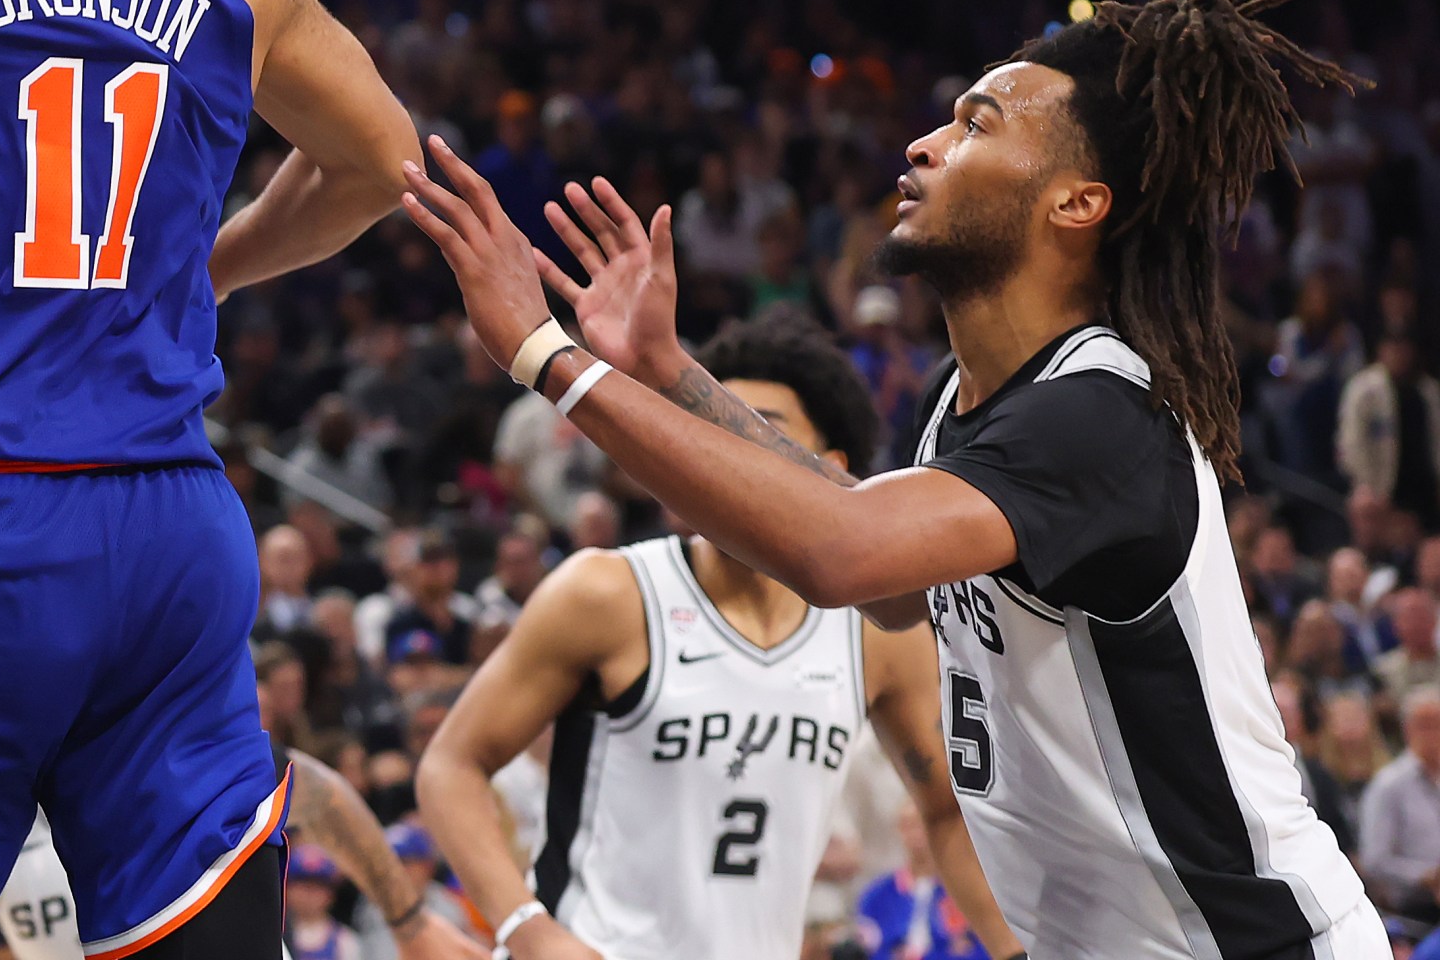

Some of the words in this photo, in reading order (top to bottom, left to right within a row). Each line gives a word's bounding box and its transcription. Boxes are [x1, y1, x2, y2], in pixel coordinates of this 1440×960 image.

[13, 56, 169, 290] 11
[652, 712, 850, 779] SPURS
[947, 668, 995, 798] 5
[710, 798, 770, 878] 2
